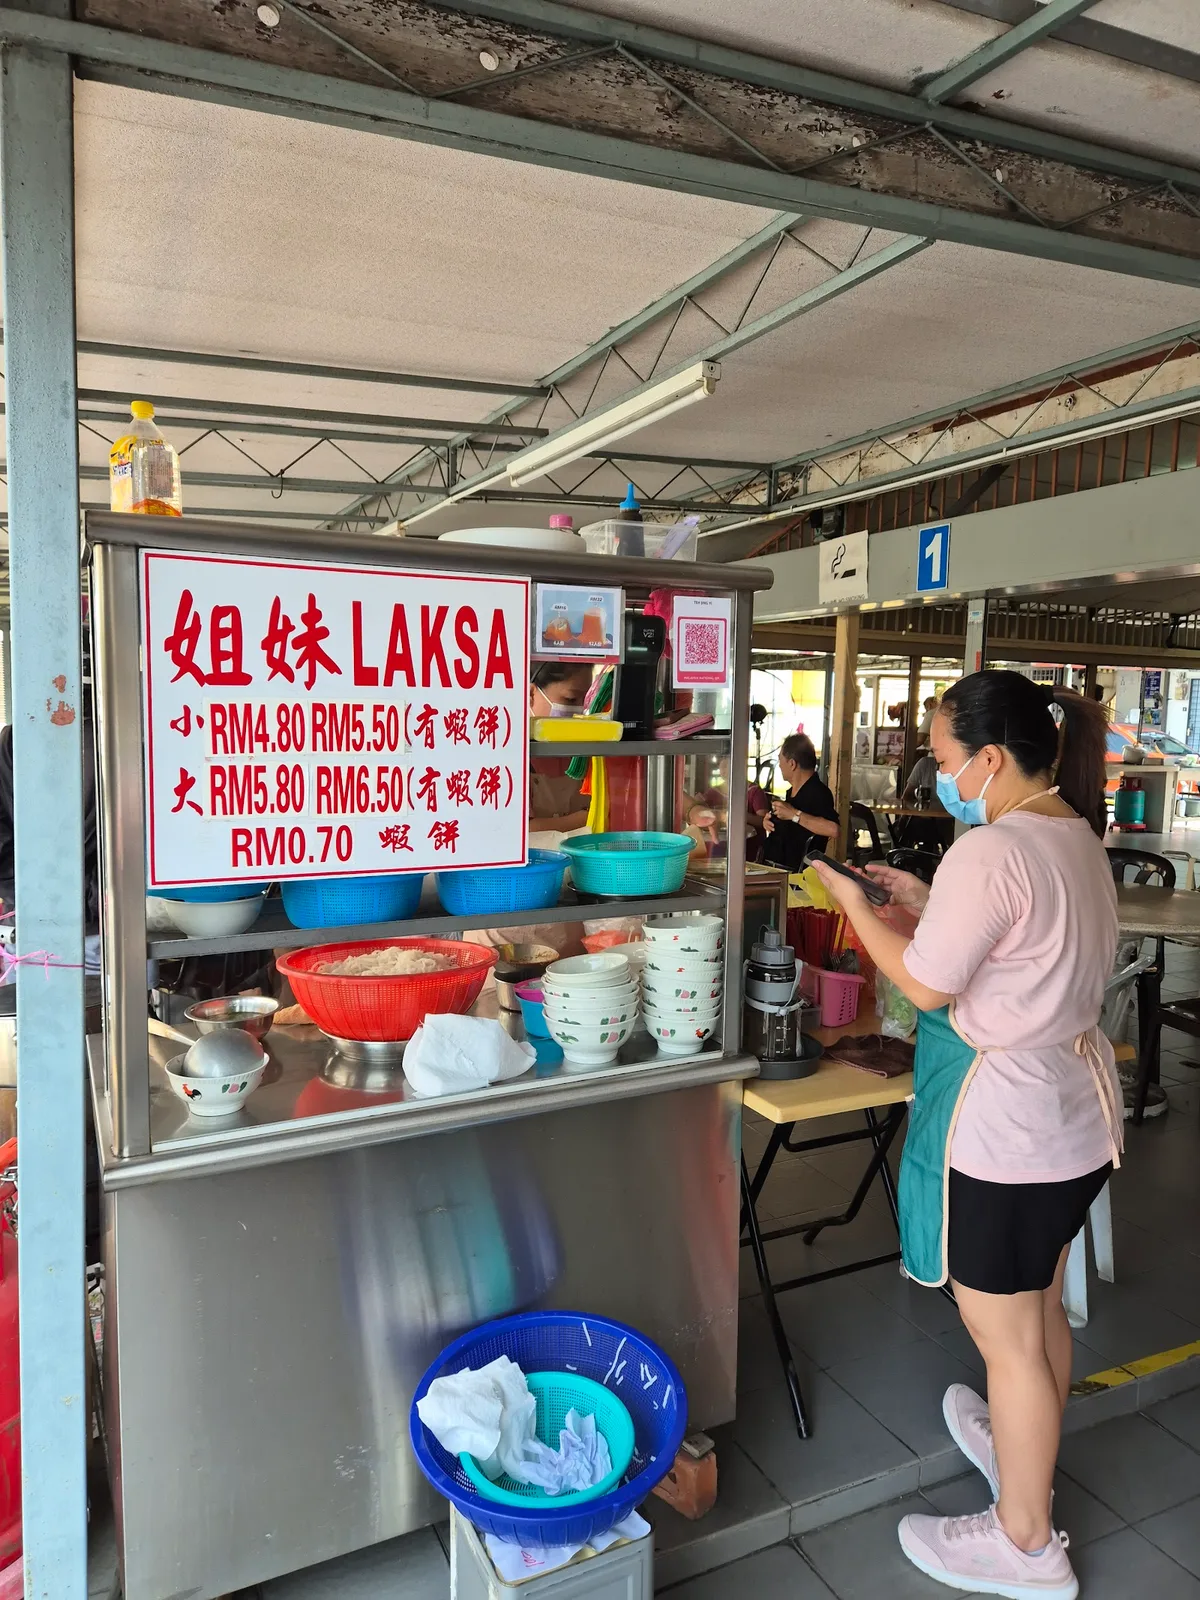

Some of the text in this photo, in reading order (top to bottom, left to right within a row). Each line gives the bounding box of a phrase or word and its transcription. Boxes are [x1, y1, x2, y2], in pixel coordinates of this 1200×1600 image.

[925, 533, 942, 583] 1
[164, 590, 514, 690] 姐妹 LAKSA
[170, 705, 204, 738] 小
[209, 703, 305, 754] RM4.80
[311, 703, 399, 752] RM5.50
[171, 767, 204, 817] 大
[209, 764, 304, 816] RM5.80
[316, 763, 404, 814] RM6.50
[231, 825, 353, 868] RM0.70
